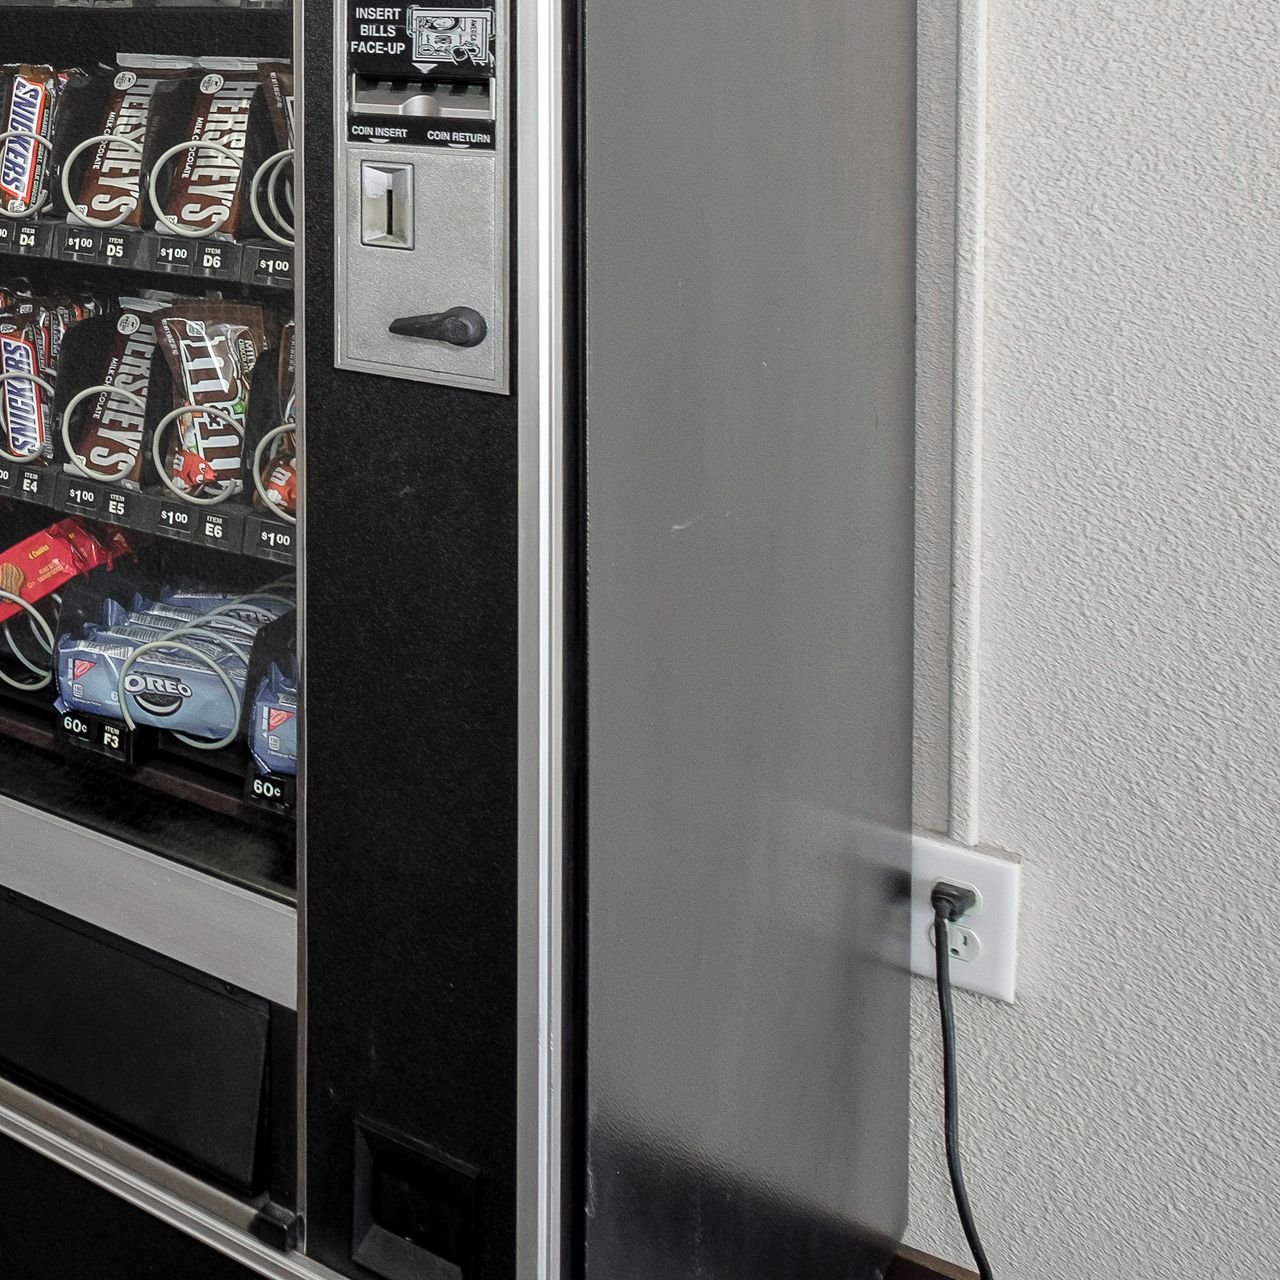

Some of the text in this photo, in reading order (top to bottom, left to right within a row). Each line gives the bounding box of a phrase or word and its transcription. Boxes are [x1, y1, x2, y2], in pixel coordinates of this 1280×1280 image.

[355, 7, 401, 20] INSERT
[360, 24, 396, 37] BILLS
[351, 42, 405, 55] FACE-UP
[351, 126, 408, 138] COIN INSERT
[427, 130, 490, 143] COIN RETURN
[93, 111, 116, 169] MILK COCOLATE
[181, 81, 262, 223] HERSHEY'S
[182, 117, 204, 179] MILK COCOLATE
[20, 234, 35, 246] D4
[107, 244, 123, 257] D5
[203, 255, 221, 268] D6
[93, 357, 118, 419] MILK CHCOLATE
[23, 479, 38, 492] E4
[109, 501, 125, 515] E5
[205, 523, 223, 538] E6
[124, 674, 193, 698] OREO
[104, 733, 119, 748] F3
